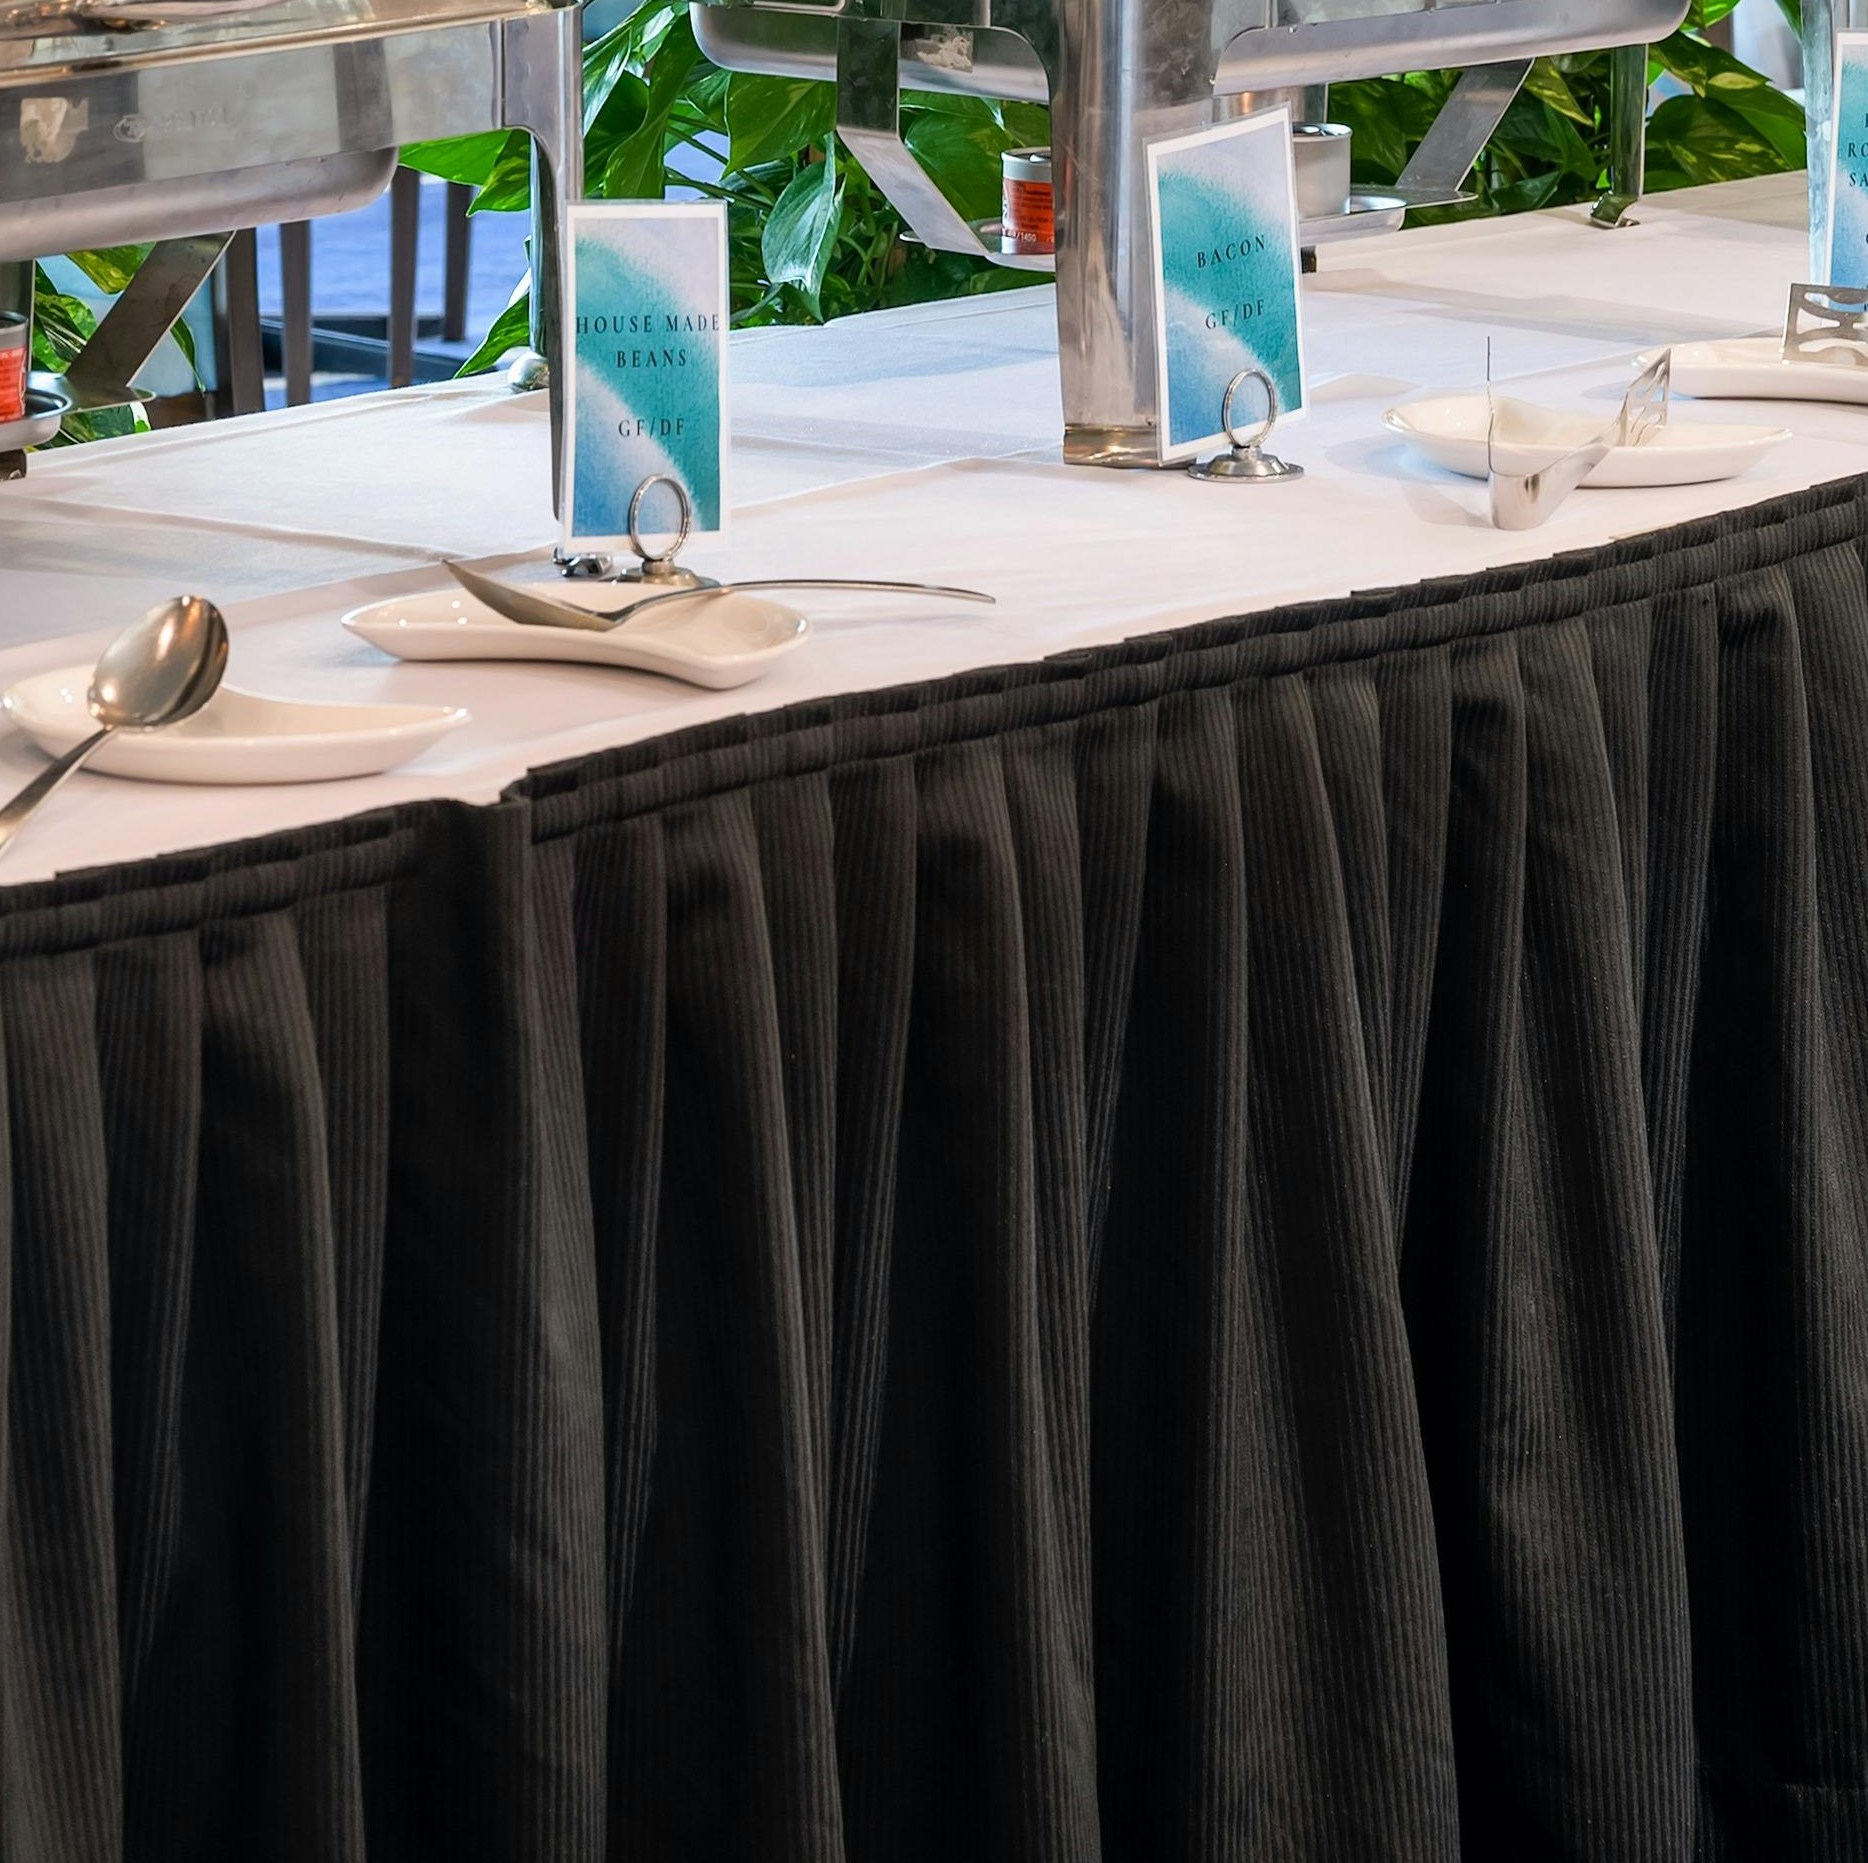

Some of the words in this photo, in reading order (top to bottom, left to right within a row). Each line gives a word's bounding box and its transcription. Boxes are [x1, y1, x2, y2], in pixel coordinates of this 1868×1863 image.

[1197, 234, 1267, 270] BACON
[576, 314, 653, 336] HOUSE
[665, 313, 720, 333] MADE
[1205, 298, 1266, 330] GF/DF
[616, 349, 687, 369] BEANS
[618, 417, 686, 439] GF/DF
